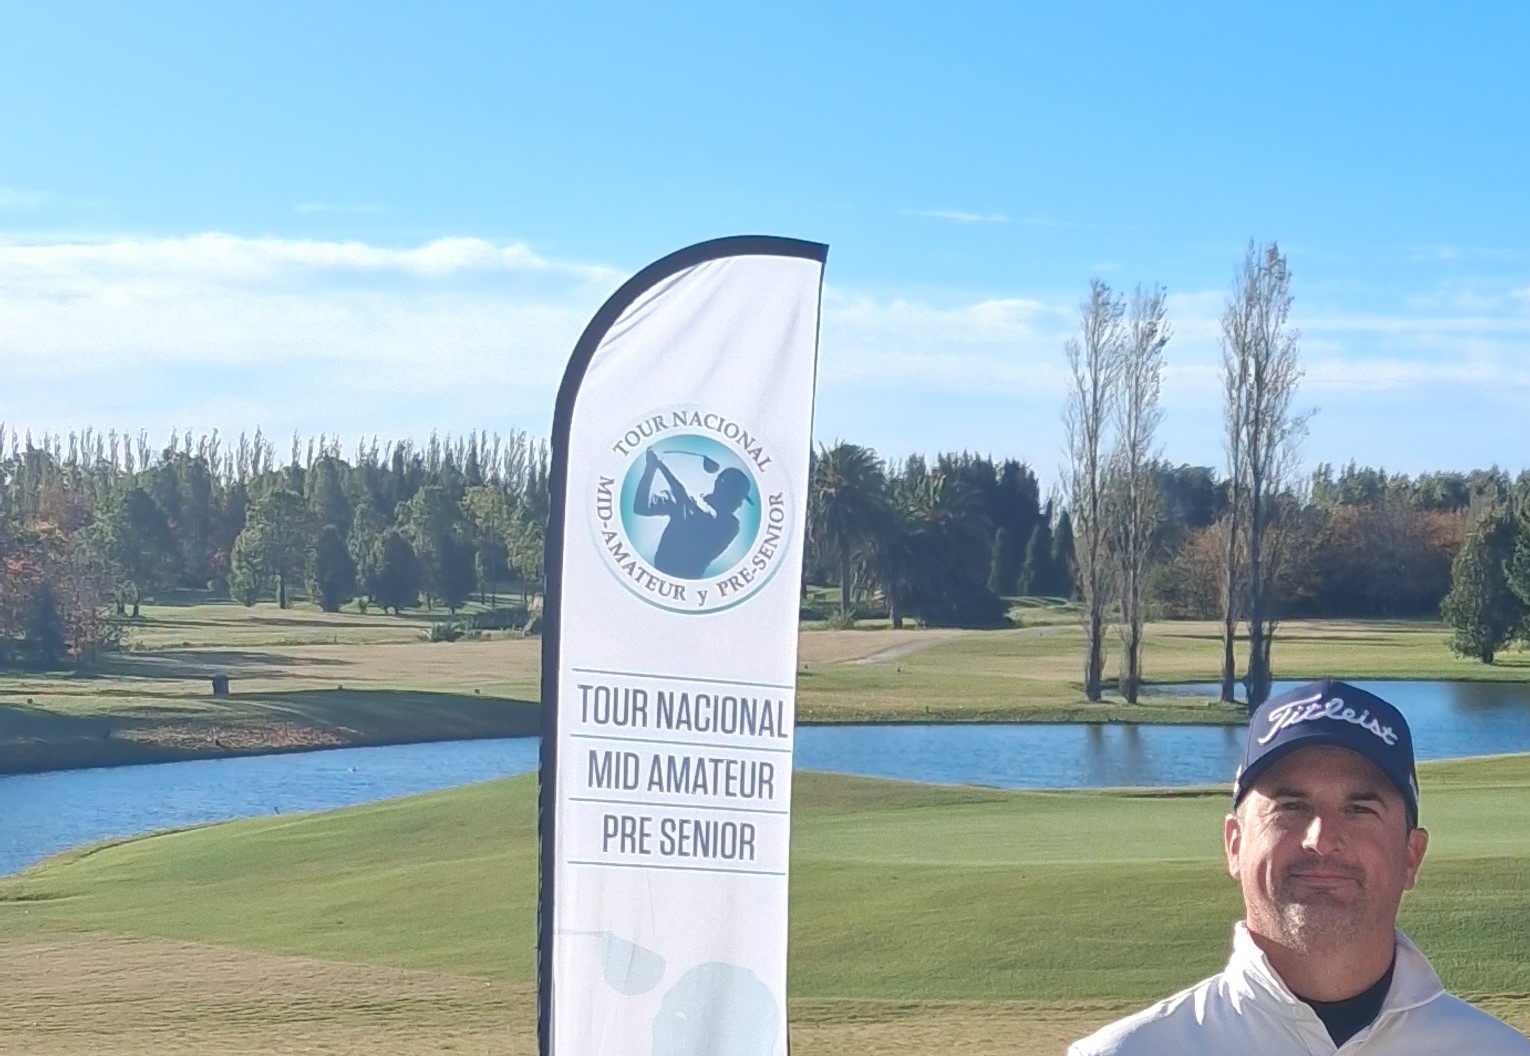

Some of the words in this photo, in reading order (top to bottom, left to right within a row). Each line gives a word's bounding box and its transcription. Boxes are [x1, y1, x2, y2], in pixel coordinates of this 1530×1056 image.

[612, 414, 669, 458] TOUR
[672, 410, 773, 473] NACIONAL
[596, 475, 687, 601] MID-AMATEUR
[696, 589, 709, 607] y
[716, 491, 784, 599] PRE-SENIOR
[576, 684, 649, 728] TOUR
[655, 690, 789, 739] NACIONAL
[1257, 693, 1399, 746] Titleist
[587, 749, 640, 791] MID
[646, 753, 775, 800] AMATEUR
[602, 814, 653, 855] PRE
[659, 817, 756, 861] SENIOR
